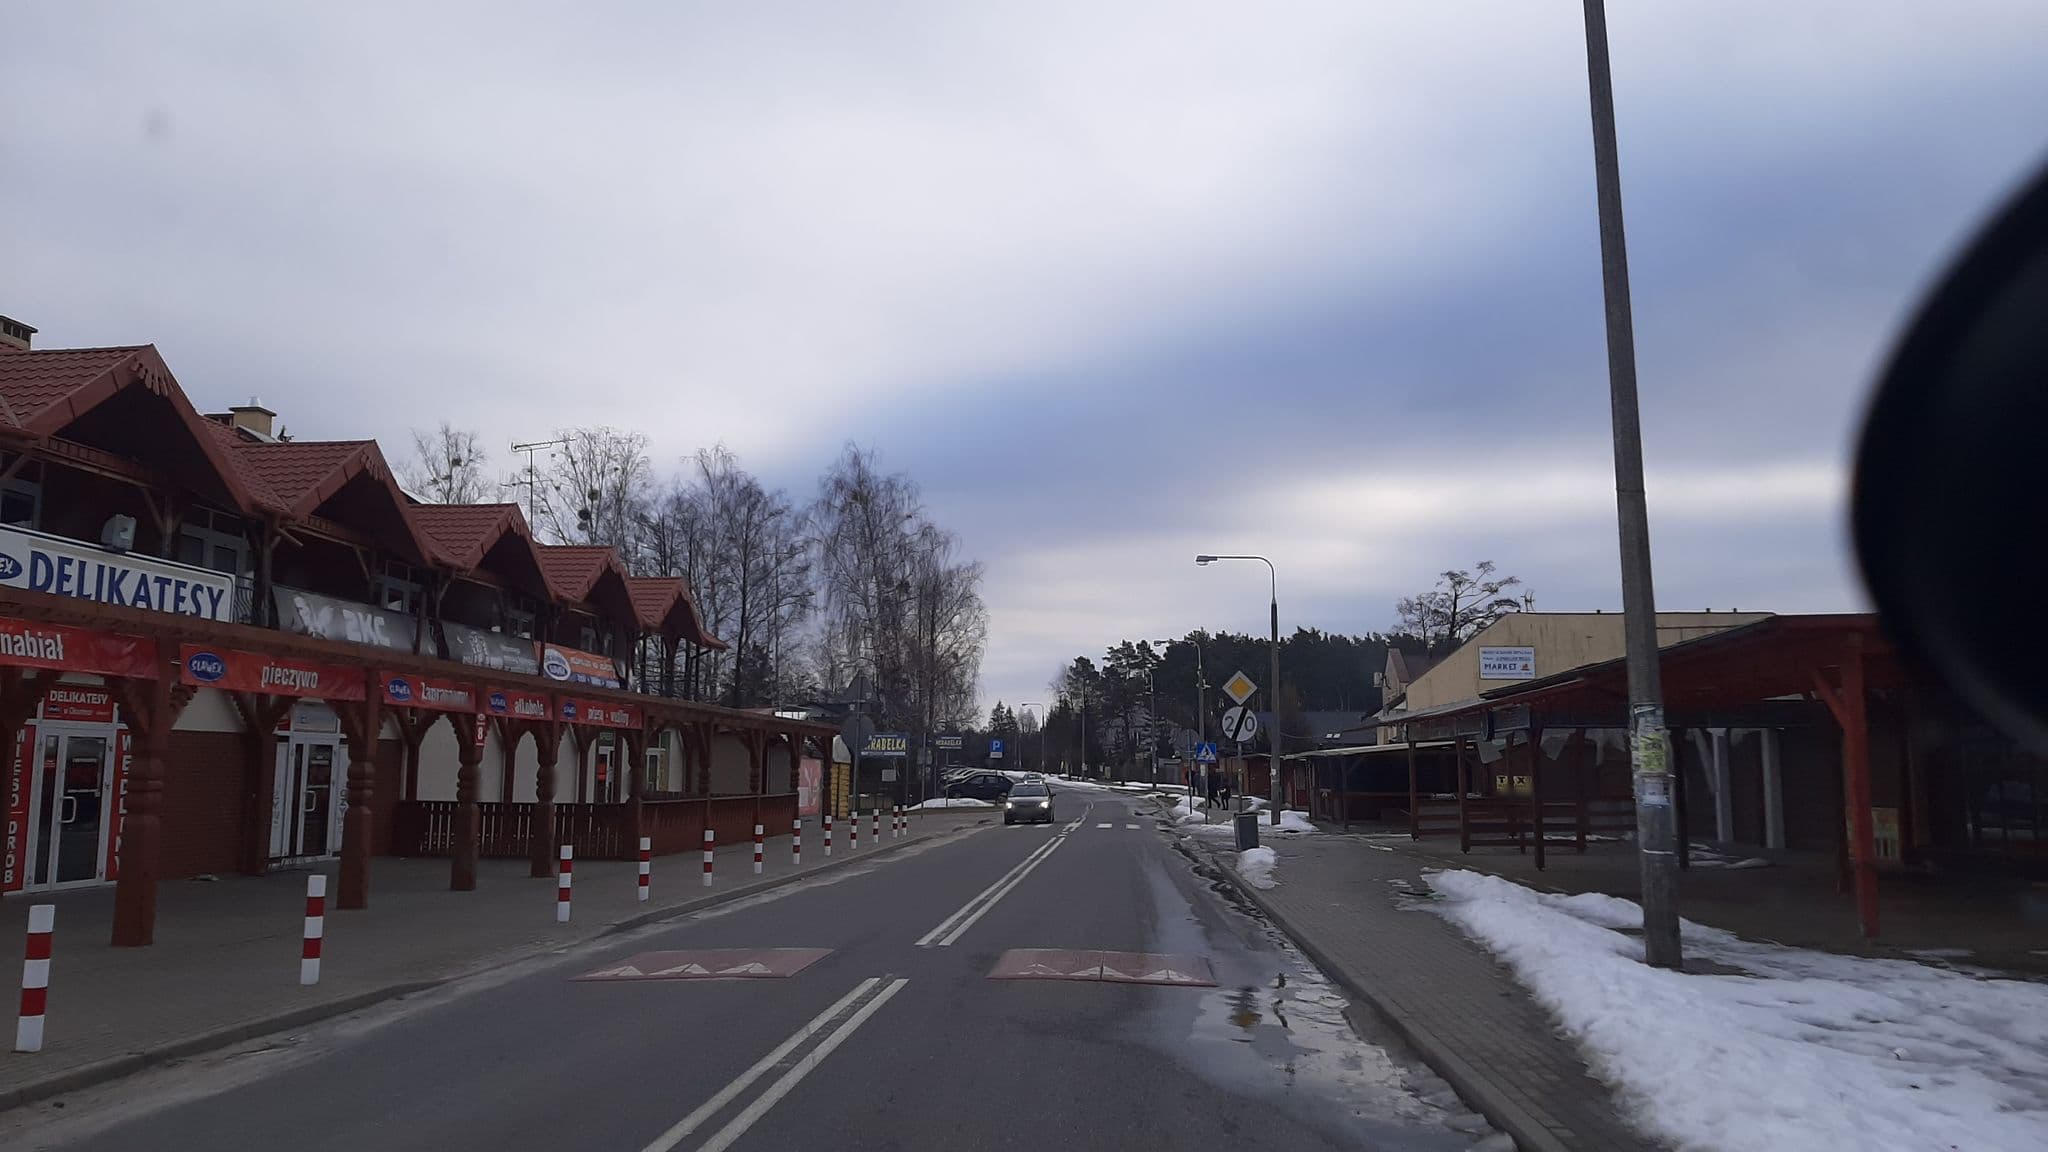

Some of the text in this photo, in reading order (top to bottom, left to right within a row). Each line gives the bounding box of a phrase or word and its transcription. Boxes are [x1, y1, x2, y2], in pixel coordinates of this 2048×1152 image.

[29, 550, 225, 621] DELIKATESY
[0, 629, 64, 661] nabiał
[261, 661, 319, 691] pieczywo
[1484, 663, 1517, 671] MARKET
[49, 690, 108, 705] DELIKATESY
[1224, 715, 1256, 733] 20
[992, 740, 1001, 751] P
[3, 820, 18, 884] DRÓB
